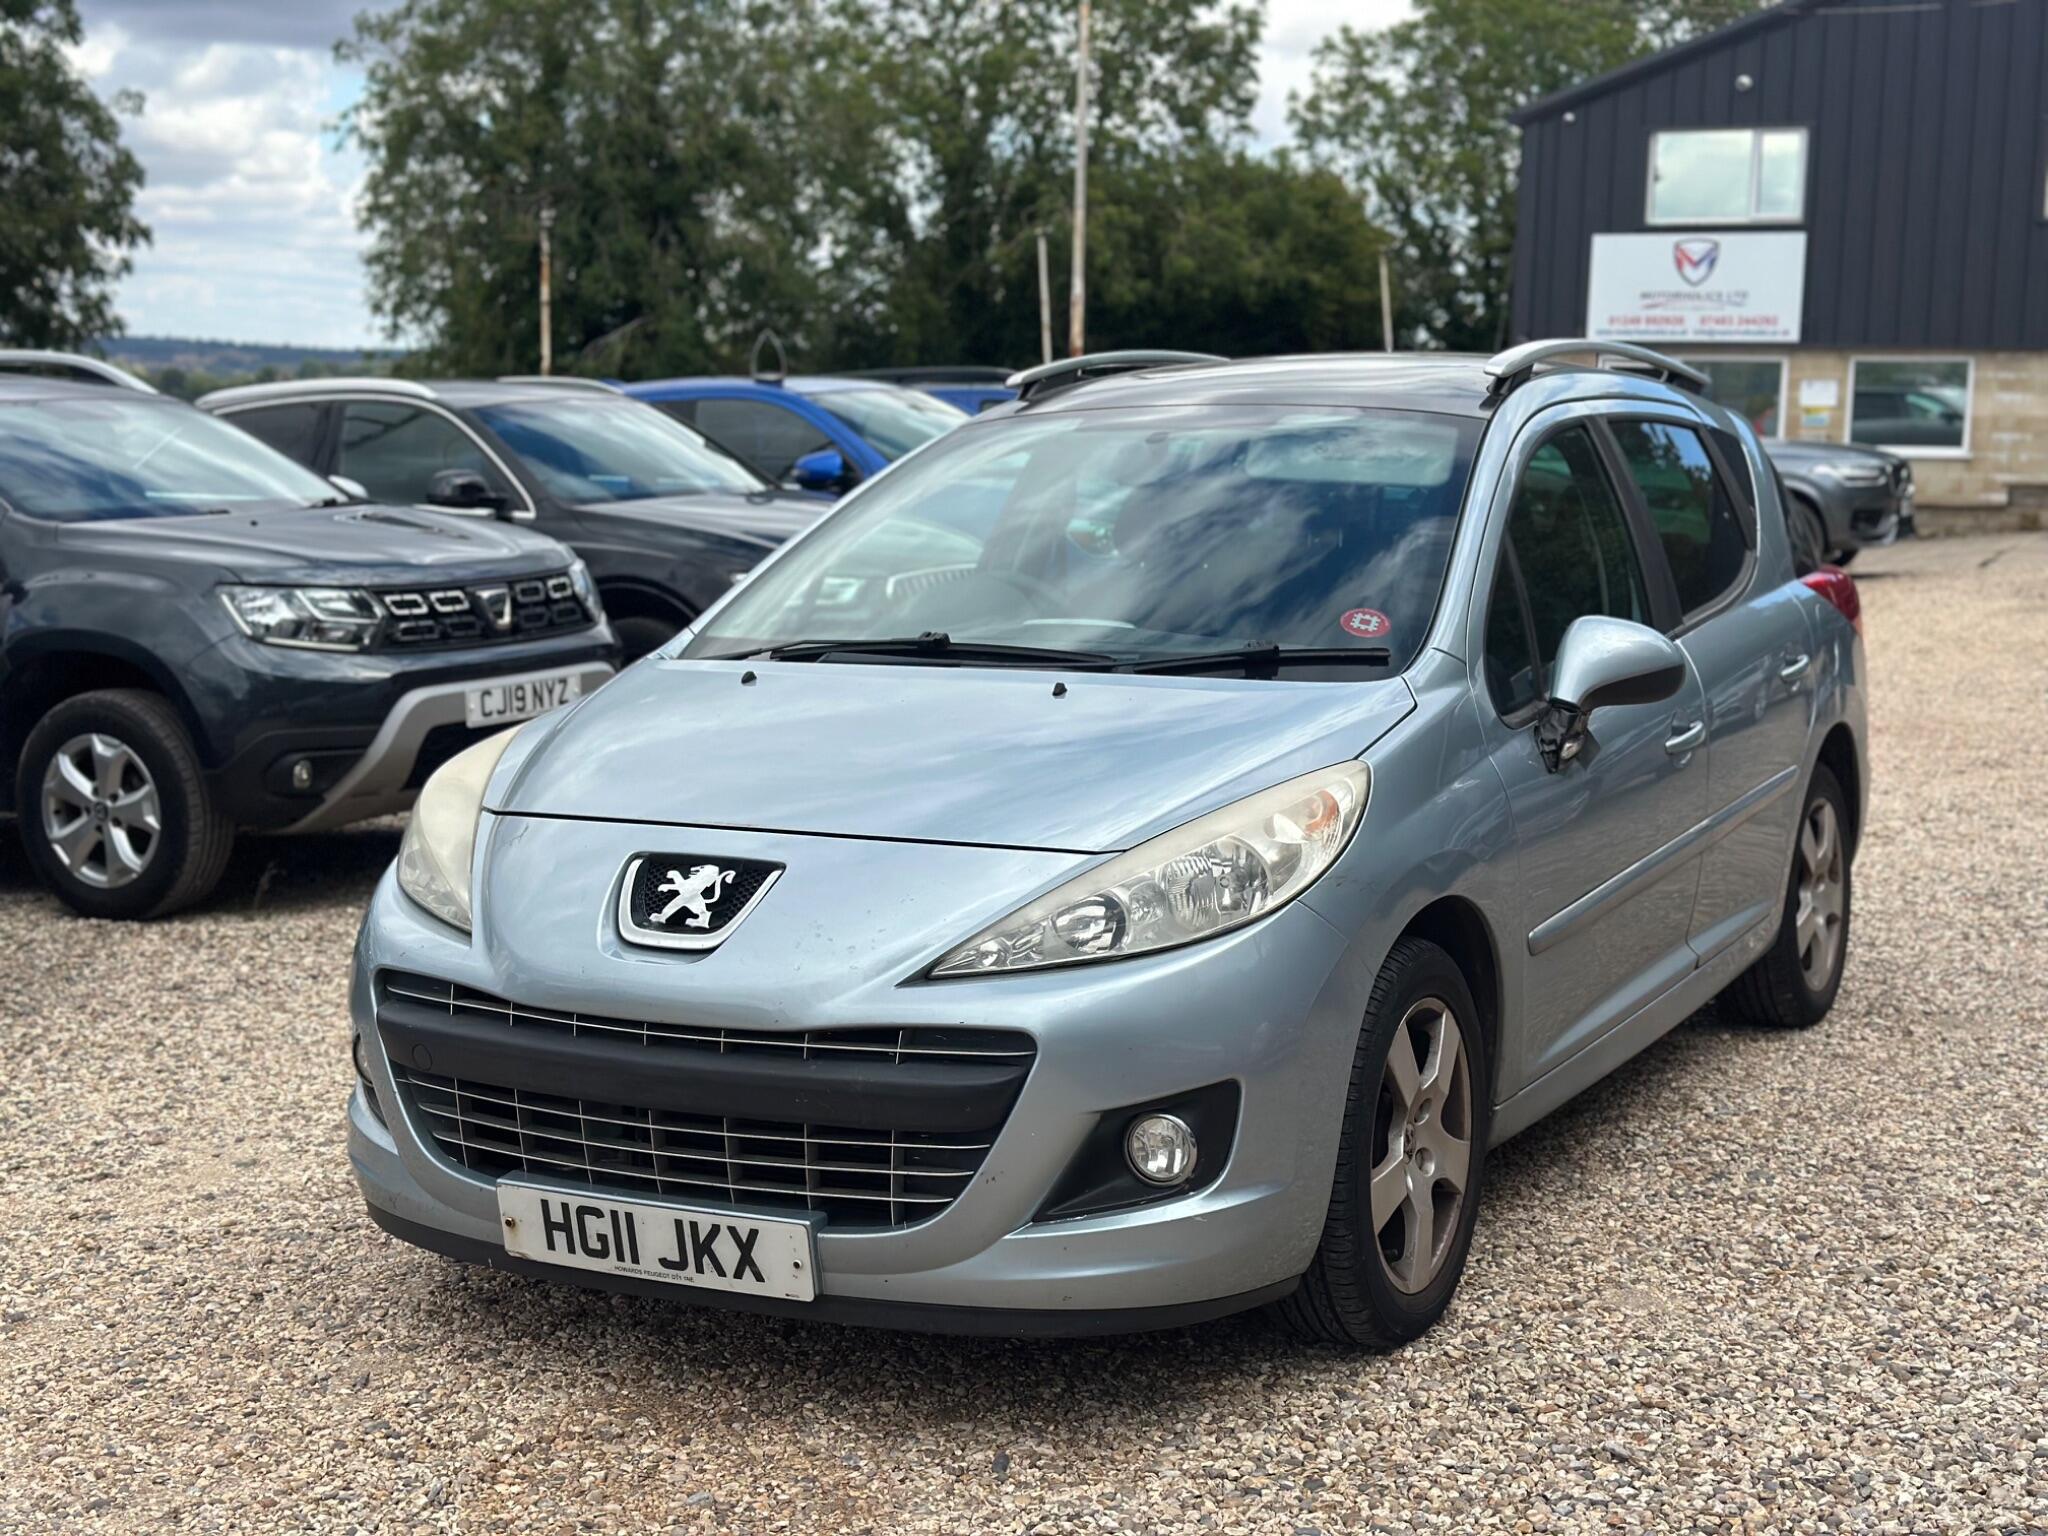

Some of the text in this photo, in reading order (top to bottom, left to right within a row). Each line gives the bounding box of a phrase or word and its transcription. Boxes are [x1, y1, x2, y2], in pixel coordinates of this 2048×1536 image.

[480, 678, 569, 717] CJ19 NYZ
[540, 1199, 765, 1283] HG11 JKX
[614, 1265, 642, 1275] HOWARDS
[643, 1269, 670, 1280] PEUGEOT
